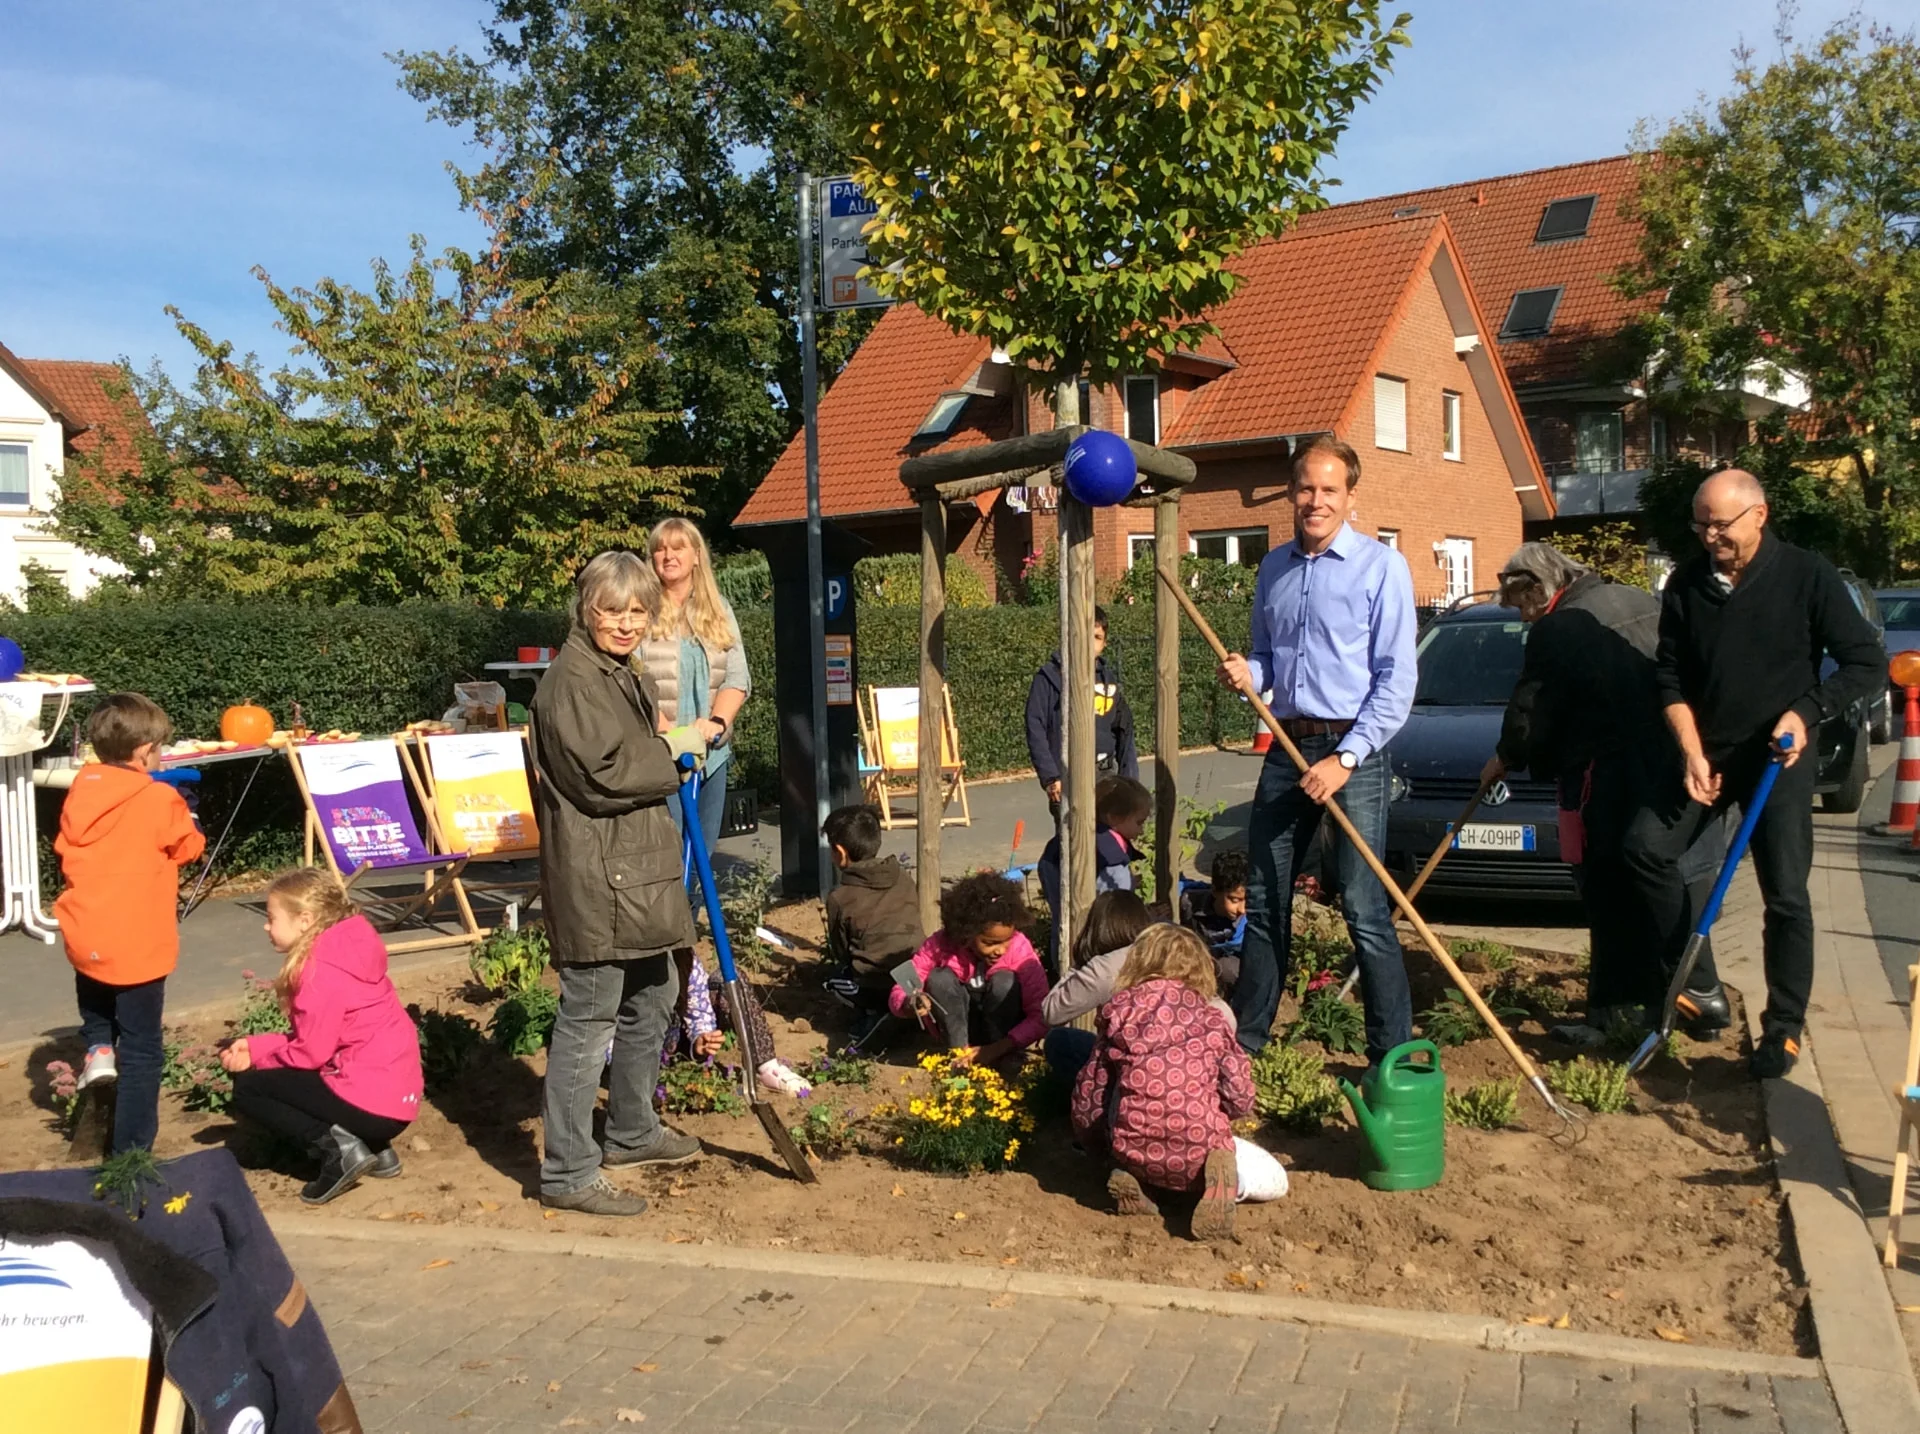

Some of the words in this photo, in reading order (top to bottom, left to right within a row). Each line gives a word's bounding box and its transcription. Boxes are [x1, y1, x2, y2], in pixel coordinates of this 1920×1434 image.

[831, 236, 868, 249] Parks
[828, 580, 841, 613] P
[332, 822, 405, 845] BITTE
[1479, 829, 1521, 845] 409HP
[0, 1313, 17, 1327] hr
[23, 1313, 88, 1328] bewegen.
